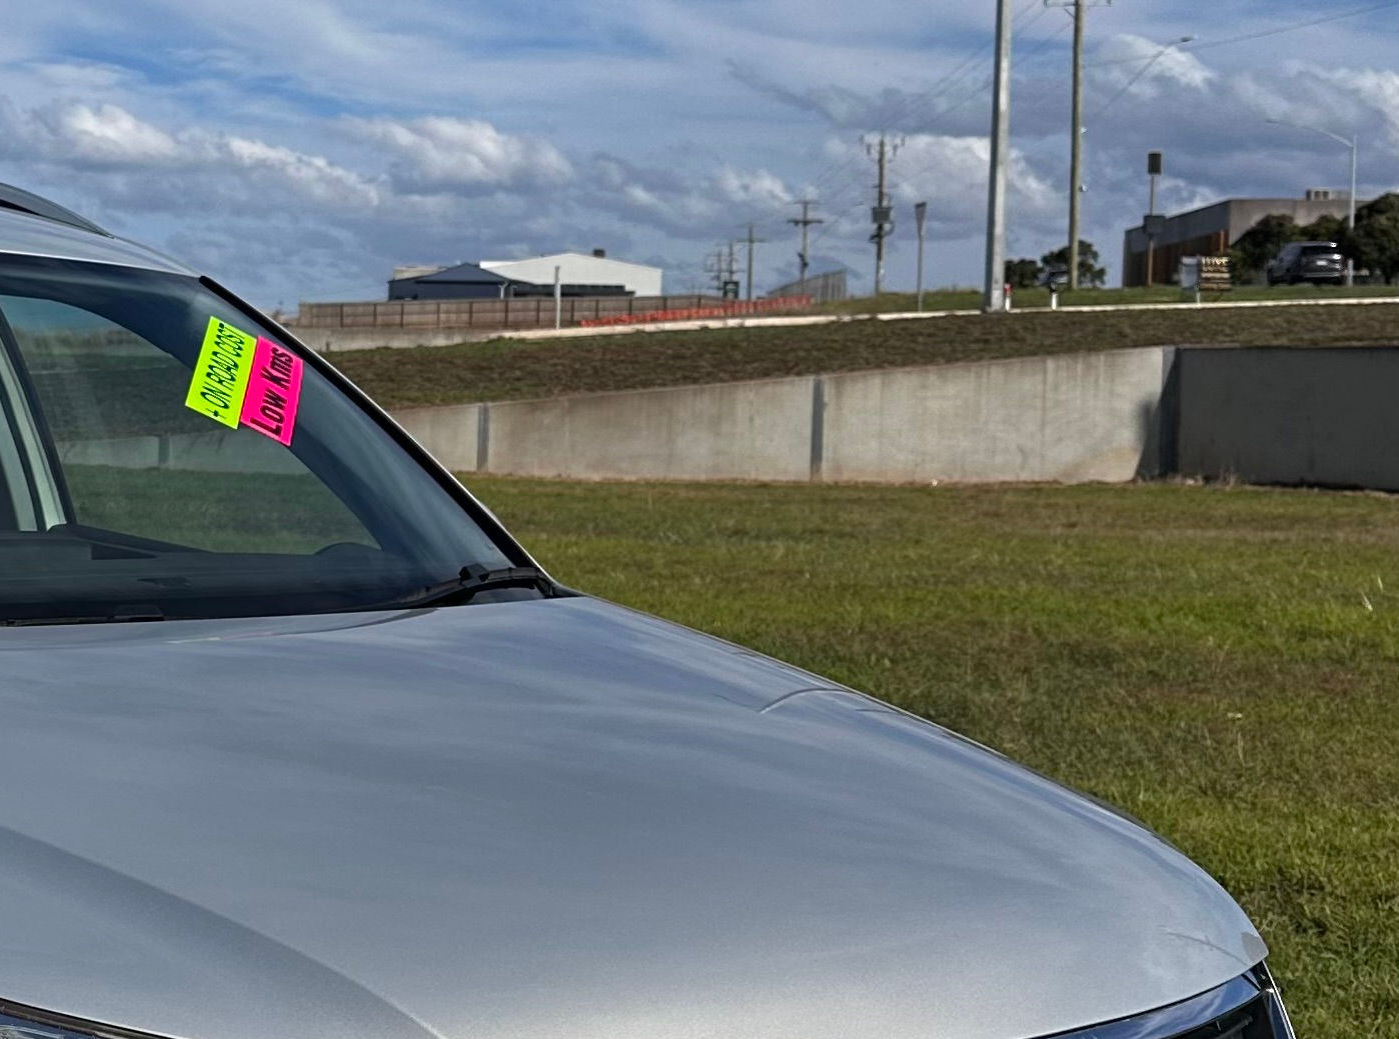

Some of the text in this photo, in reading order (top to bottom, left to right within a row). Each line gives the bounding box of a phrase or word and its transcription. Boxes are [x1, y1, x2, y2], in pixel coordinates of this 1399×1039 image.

[214, 322, 245, 358] COST
[205, 351, 239, 391] ROAD
[200, 381, 232, 409] ON
[250, 347, 294, 437] Low Kms
